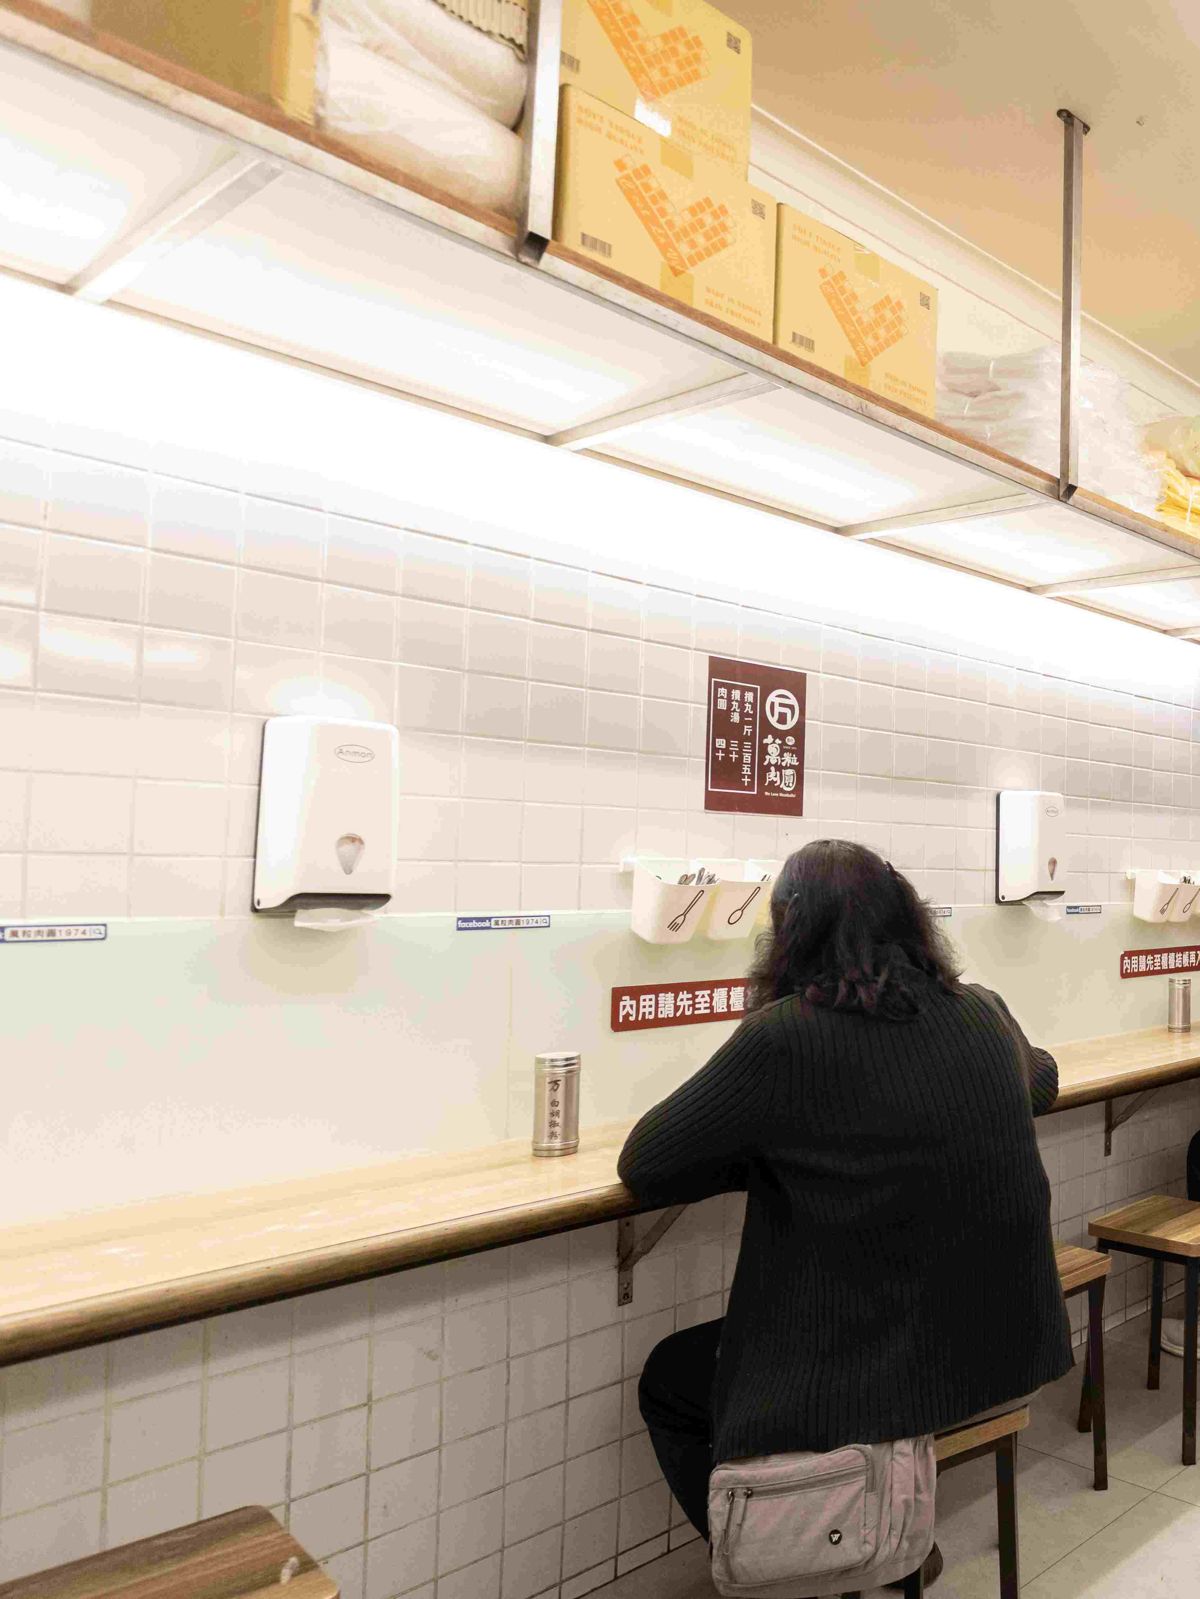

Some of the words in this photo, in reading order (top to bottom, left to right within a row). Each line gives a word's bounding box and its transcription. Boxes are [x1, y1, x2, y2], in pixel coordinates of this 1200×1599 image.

[715, 738, 726, 761] 四十
[729, 740, 739, 762] 三十
[741, 741, 752, 786] 三百五十
[458, 918, 491, 928] facebook
[619, 986, 746, 1023] 內用請先至櫃檯
